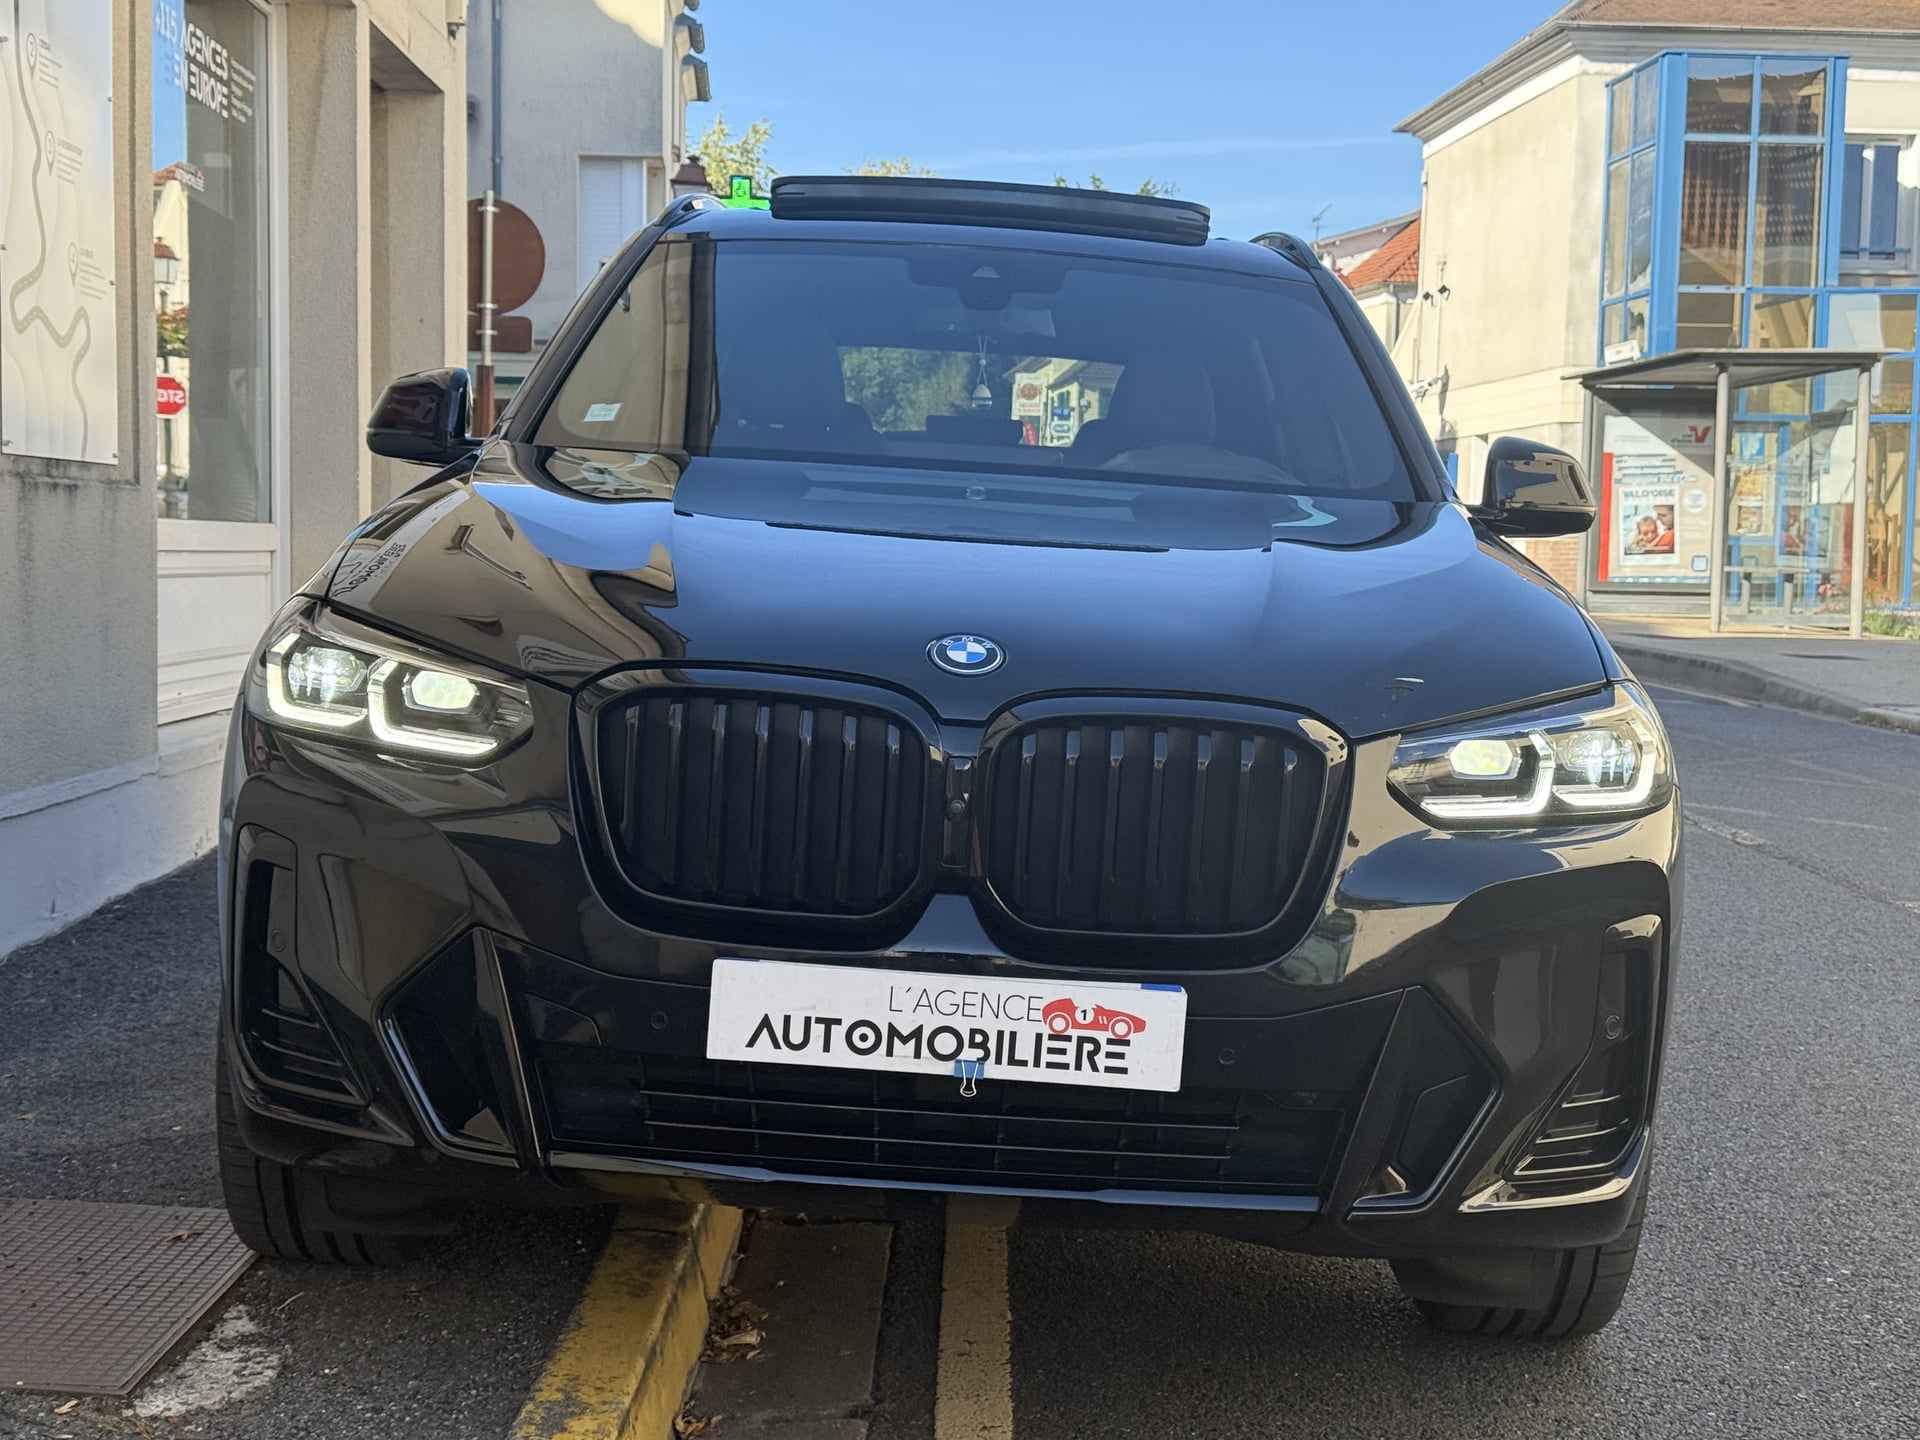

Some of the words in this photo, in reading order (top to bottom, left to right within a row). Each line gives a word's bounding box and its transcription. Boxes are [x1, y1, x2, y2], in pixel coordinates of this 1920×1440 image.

[180, 19, 228, 81] AGENCES
[190, 63, 229, 119] EUROPE
[942, 636, 995, 649] BMW
[888, 985, 1044, 1023] L'AGENCE
[745, 1012, 1131, 1075] AUTOMOBILIERE
